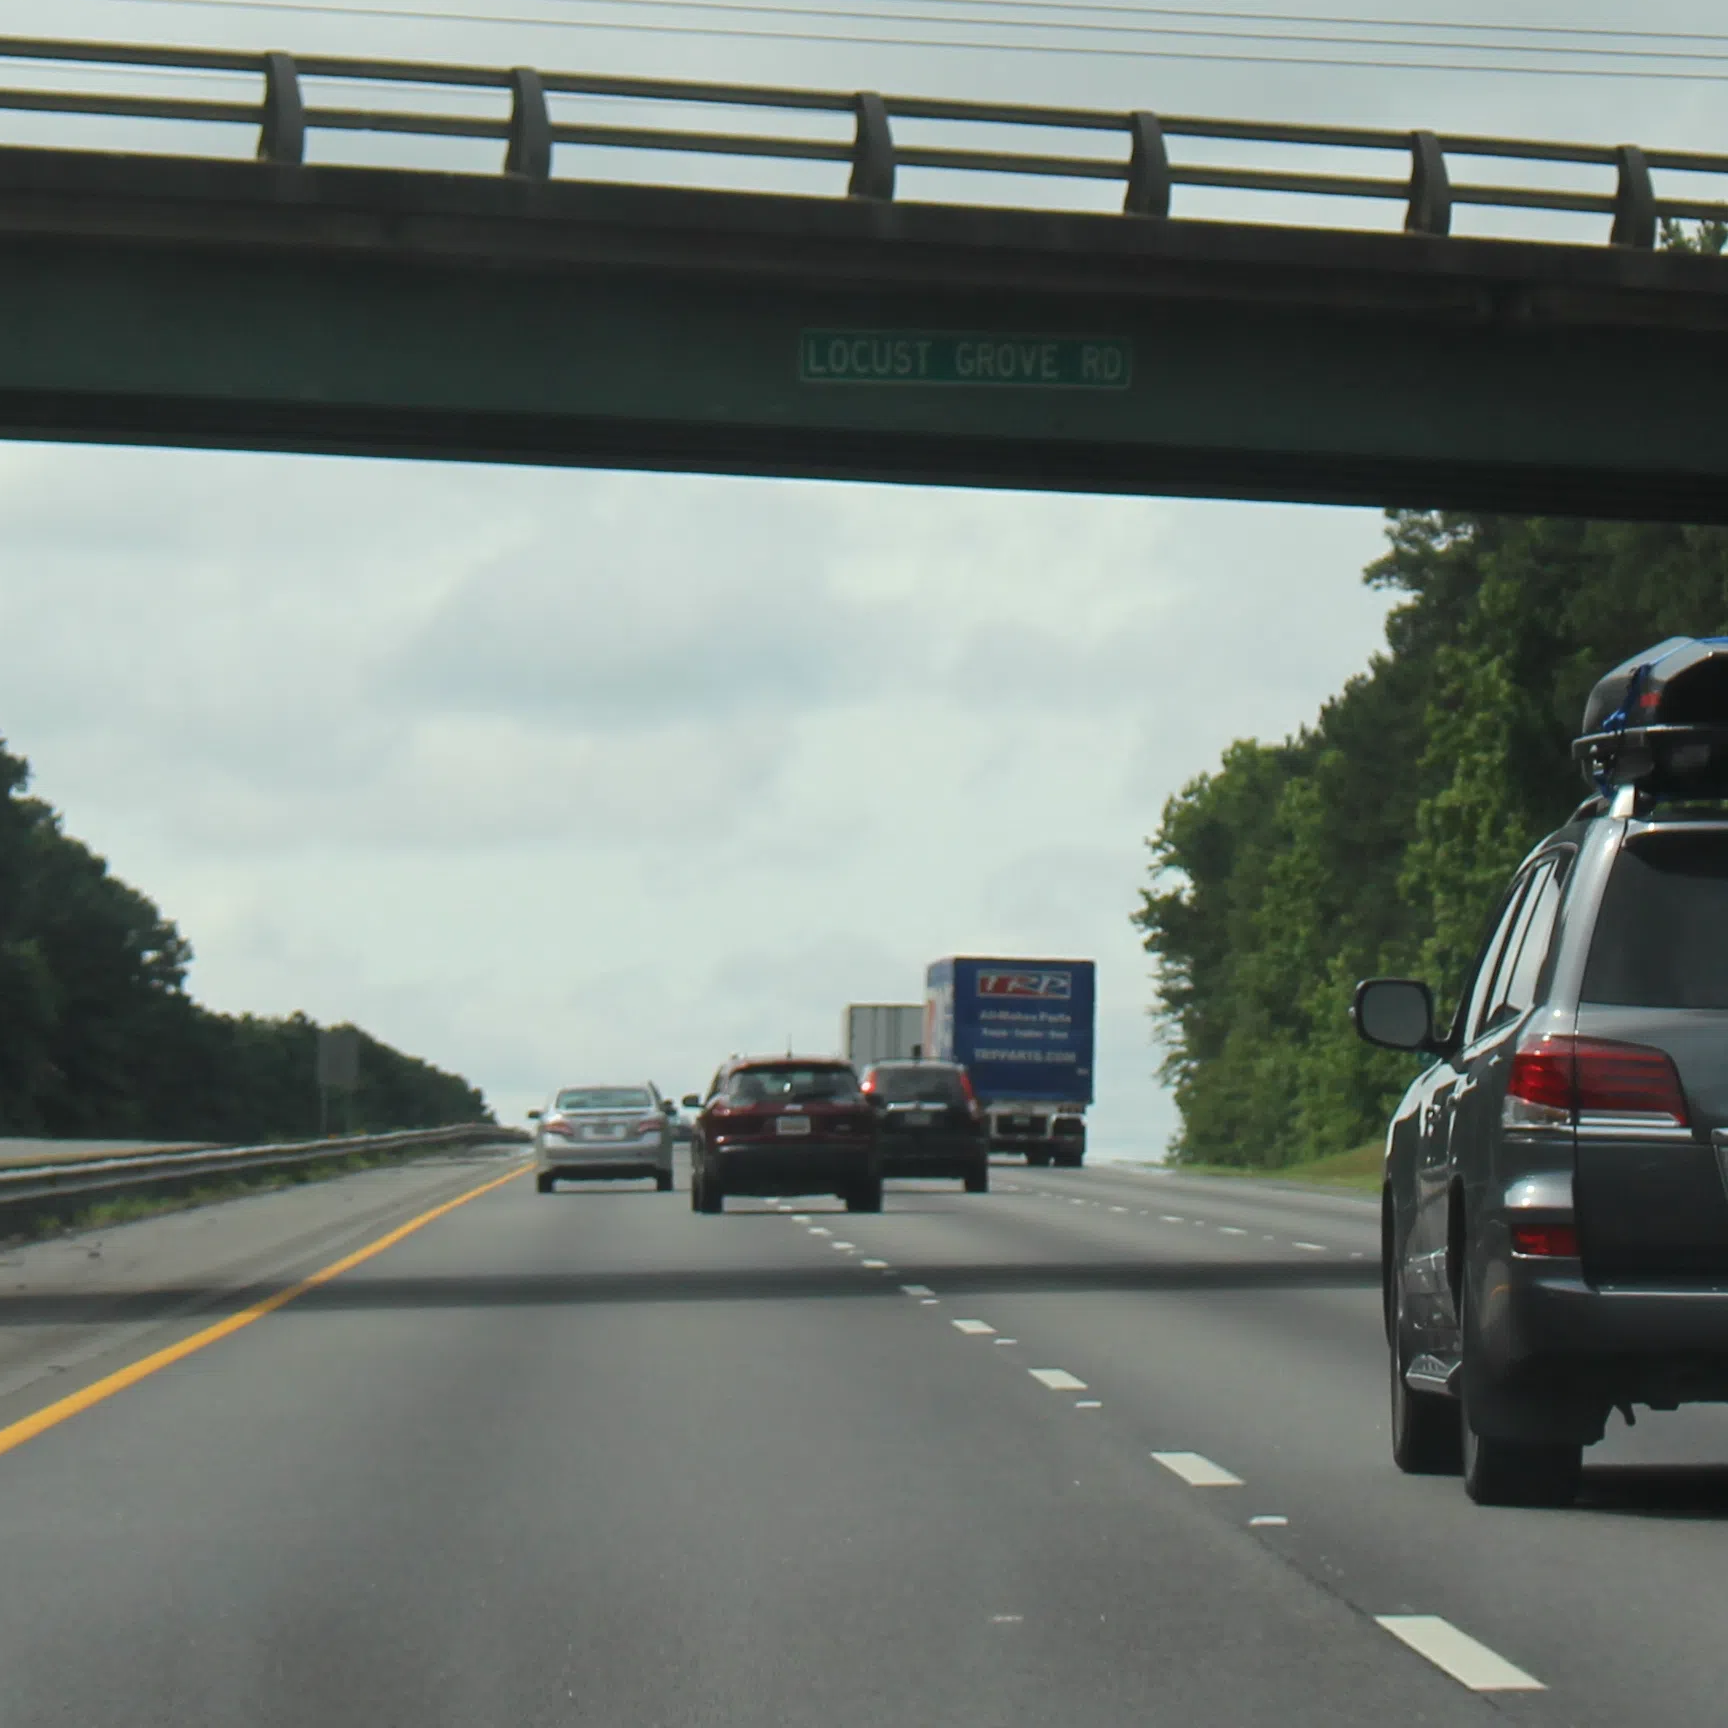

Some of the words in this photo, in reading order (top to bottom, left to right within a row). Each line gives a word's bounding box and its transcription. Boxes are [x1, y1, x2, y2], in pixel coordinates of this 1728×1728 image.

[807, 339, 932, 375] LOCUST
[954, 342, 1059, 379] GROVE
[1081, 345, 1122, 381] RD
[979, 972, 1070, 997] TRP
